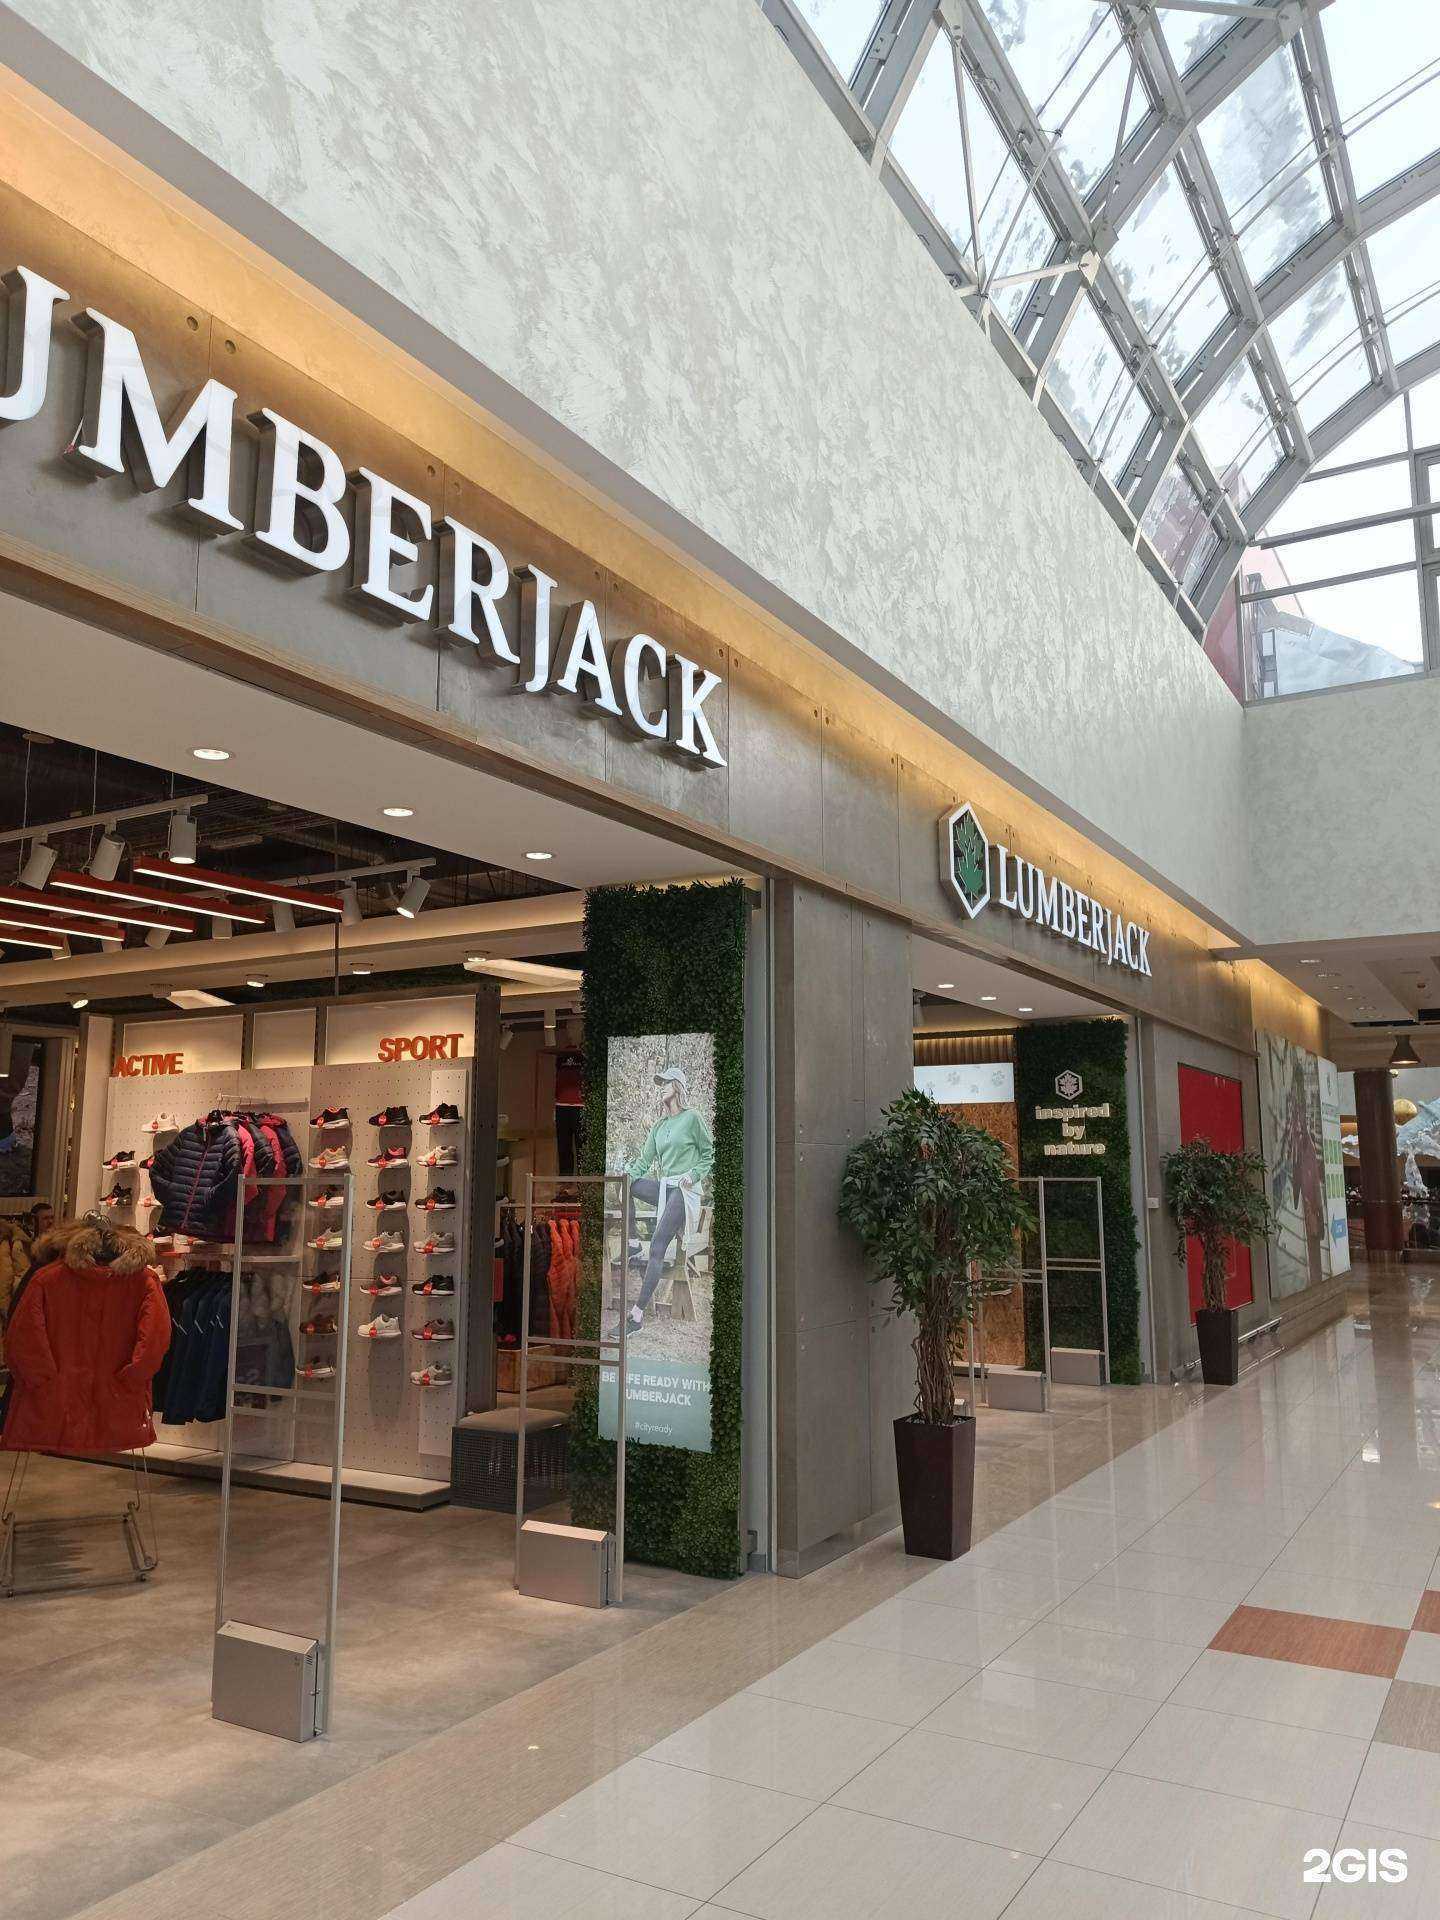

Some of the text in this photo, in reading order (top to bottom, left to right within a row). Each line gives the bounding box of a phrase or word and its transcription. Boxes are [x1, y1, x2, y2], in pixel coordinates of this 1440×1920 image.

[0, 264, 728, 768] UMBERJACK
[997, 843, 1153, 977] LUMBERJACK
[377, 1033, 465, 1063] SPORT
[112, 1052, 184, 1078] ACTIVE
[1034, 1102, 1111, 1122] inspired
[1061, 1122, 1086, 1140] by
[1043, 1141, 1107, 1156] nature
[601, 1371, 712, 1393] BE IFE READY WITH
[625, 1388, 692, 1407] UMBERJACK
[634, 1421, 673, 1437] #cityready
